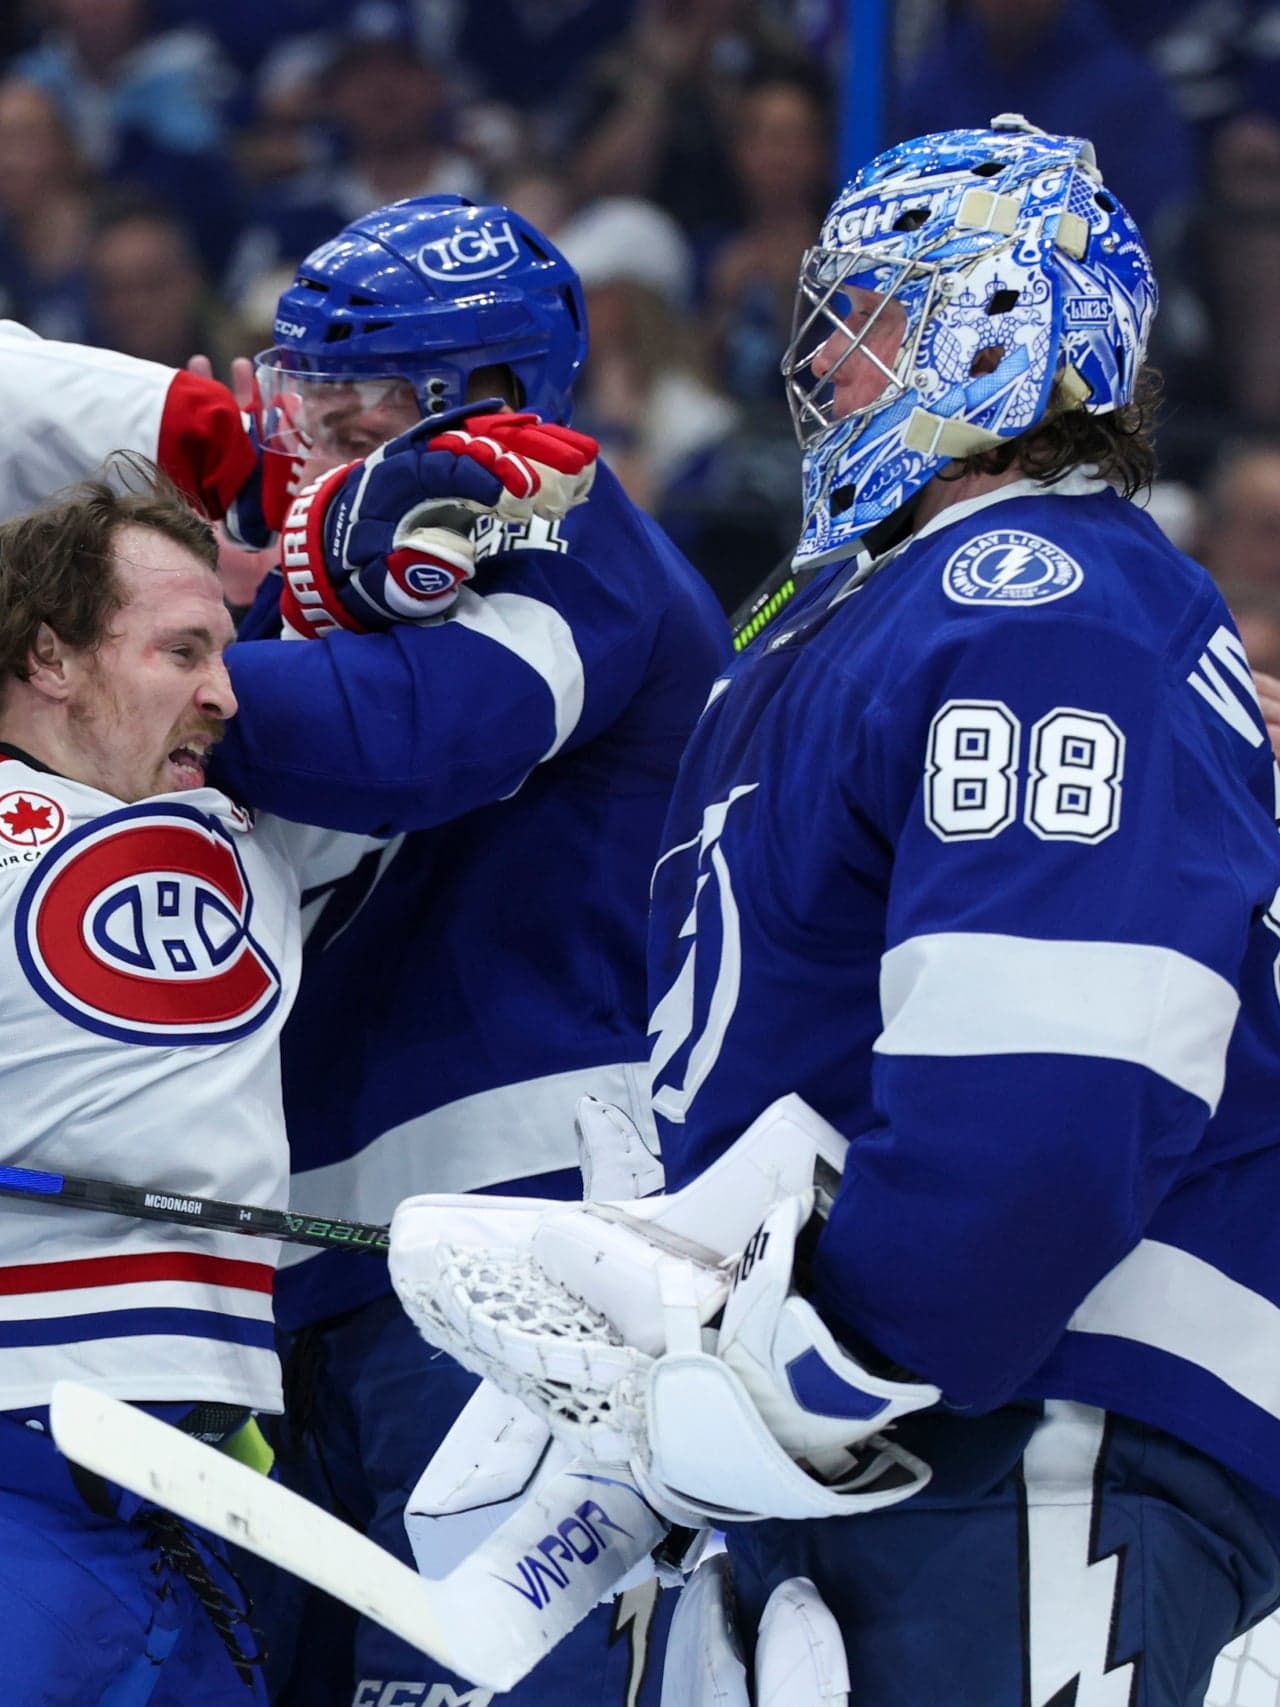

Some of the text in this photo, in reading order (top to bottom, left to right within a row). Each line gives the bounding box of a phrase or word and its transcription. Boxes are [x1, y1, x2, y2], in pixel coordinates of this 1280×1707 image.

[421, 221, 519, 270] TGH
[964, 534, 1000, 558] BAY
[923, 698, 1127, 846] 88
[144, 1193, 203, 1216] MCDONAGH
[488, 1499, 635, 1611] VAPOR
